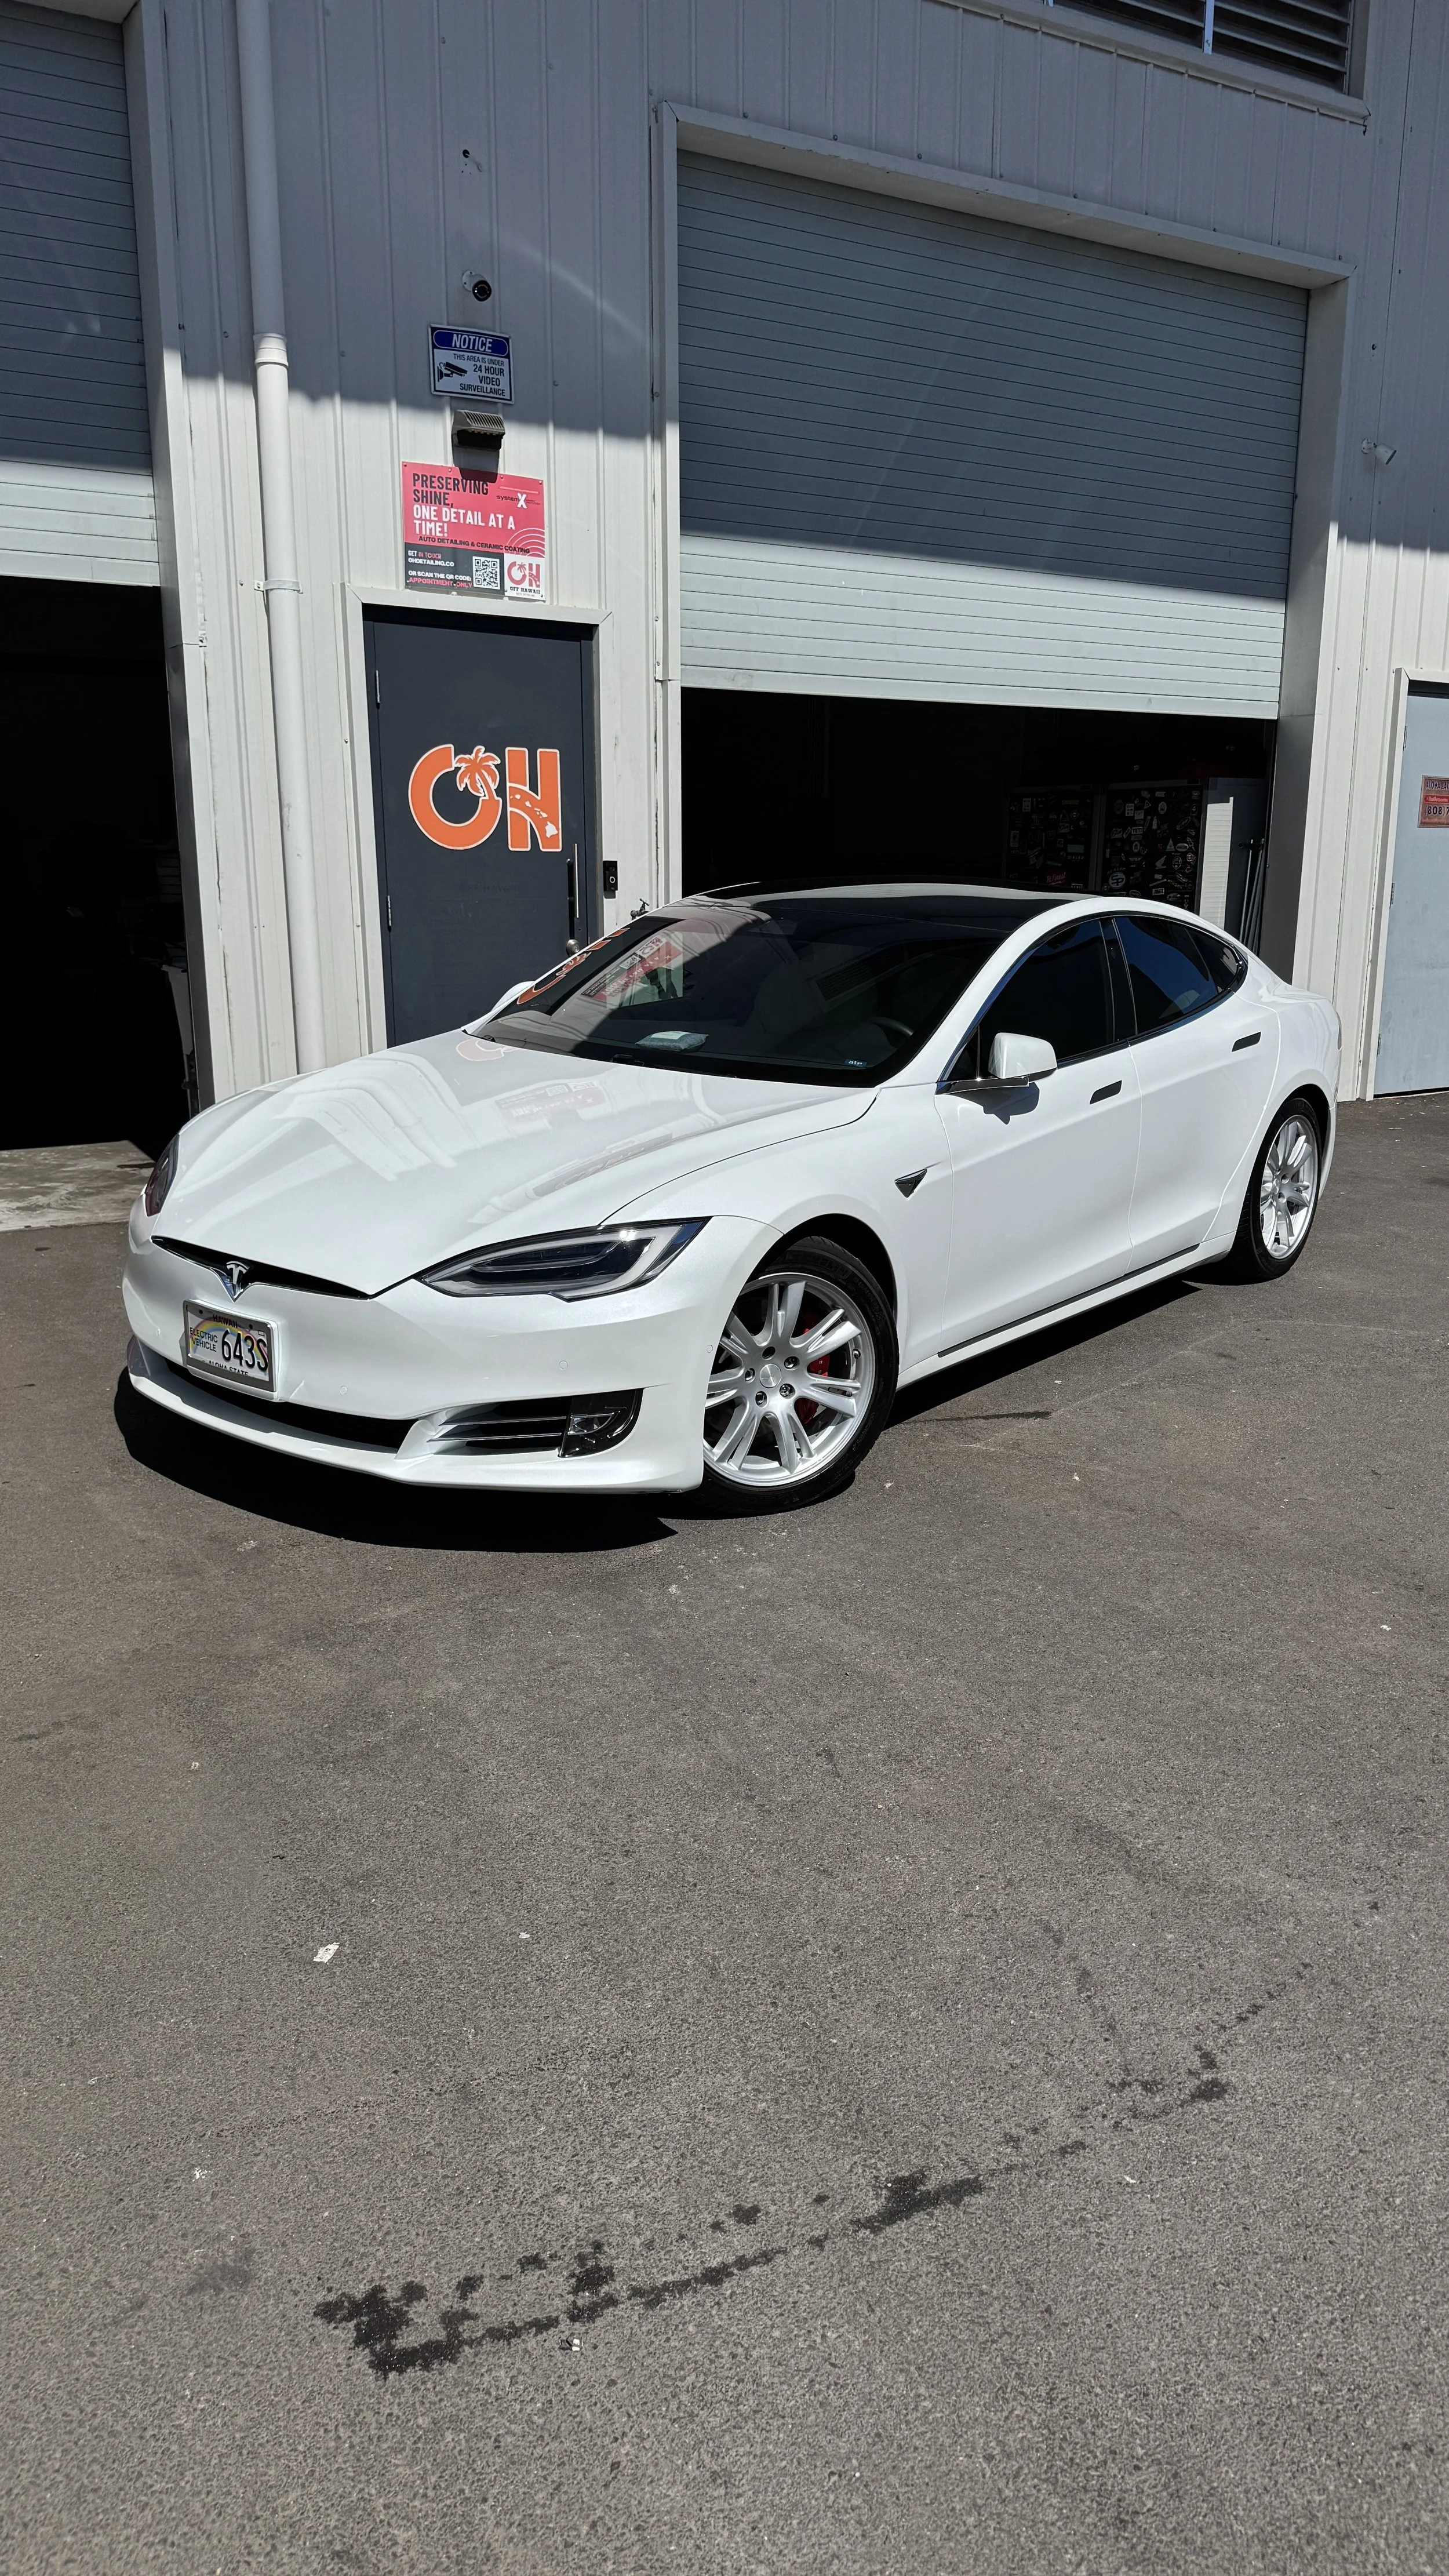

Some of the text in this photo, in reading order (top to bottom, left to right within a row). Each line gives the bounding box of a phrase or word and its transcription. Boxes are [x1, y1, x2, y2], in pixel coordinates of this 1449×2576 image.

[452, 334, 493, 352] NOTICE
[467, 355, 480, 363] AREA
[487, 358, 504, 367] UNDER
[474, 364, 504, 377] 24 HOUR
[478, 375, 500, 386] VIDEO
[460, 383, 505, 396] SURVEILLANCE
[413, 473, 489, 495] PRESERVING
[413, 489, 454, 508] SHINE,
[413, 504, 515, 530] ONE DETAIL AT A
[413, 520, 447, 537] TIME!
[437, 538, 469, 546] DETAILING
[476, 542, 503, 550] CERAMIC
[504, 545, 530, 554] COATING
[409, 577, 453, 586] APPOINTMENT
[213, 1314, 238, 1329] HAWAII
[190, 1327, 218, 1343] ELECTRIC
[192, 1338, 217, 1352] VEHICLE
[222, 1329, 269, 1371] 643S
